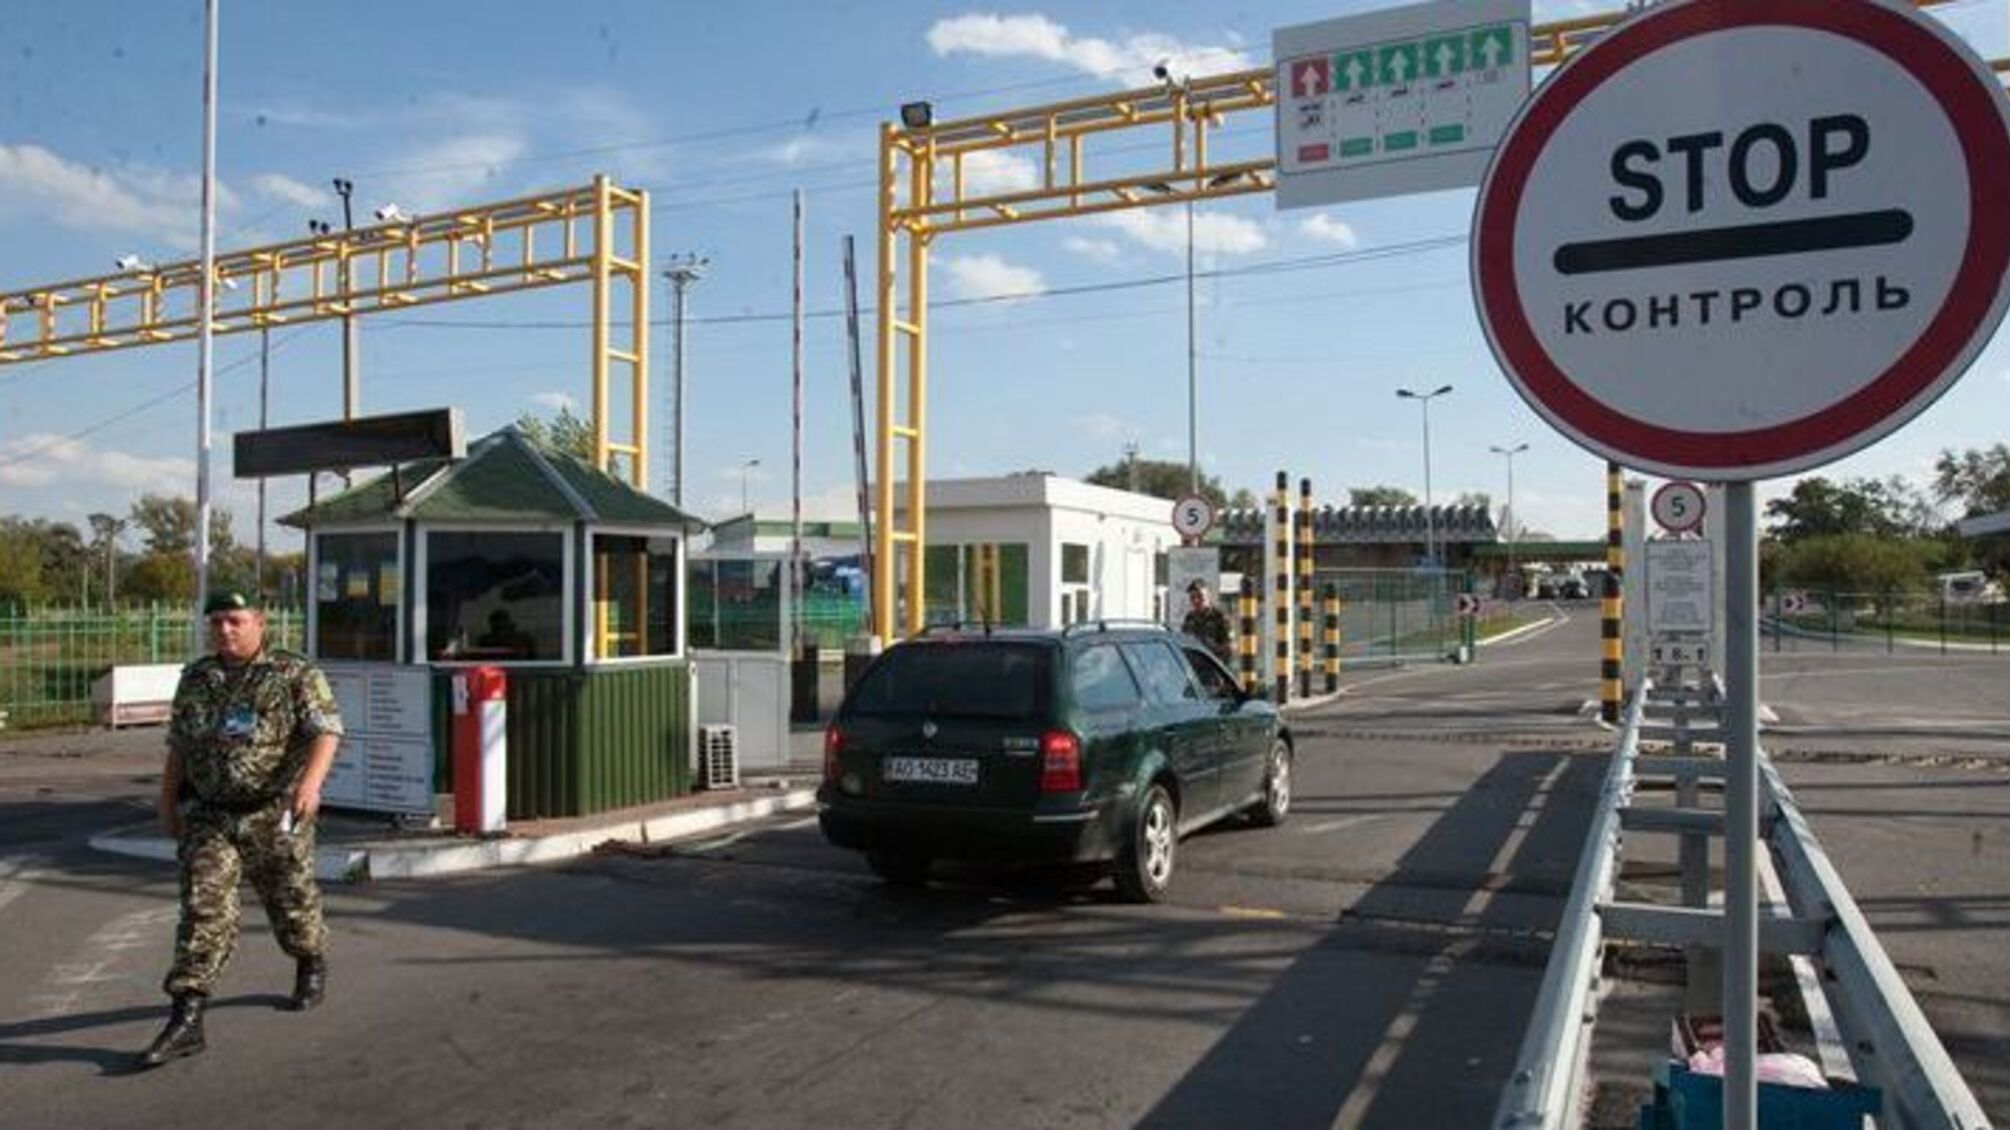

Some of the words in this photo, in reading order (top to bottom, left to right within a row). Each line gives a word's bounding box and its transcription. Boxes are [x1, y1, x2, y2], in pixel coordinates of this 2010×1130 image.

[1608, 113, 1872, 223] STOP
[1563, 274, 1912, 336] КОНТРОЛЬ
[1186, 507, 1199, 527] 5
[1670, 495, 1687, 518] 5
